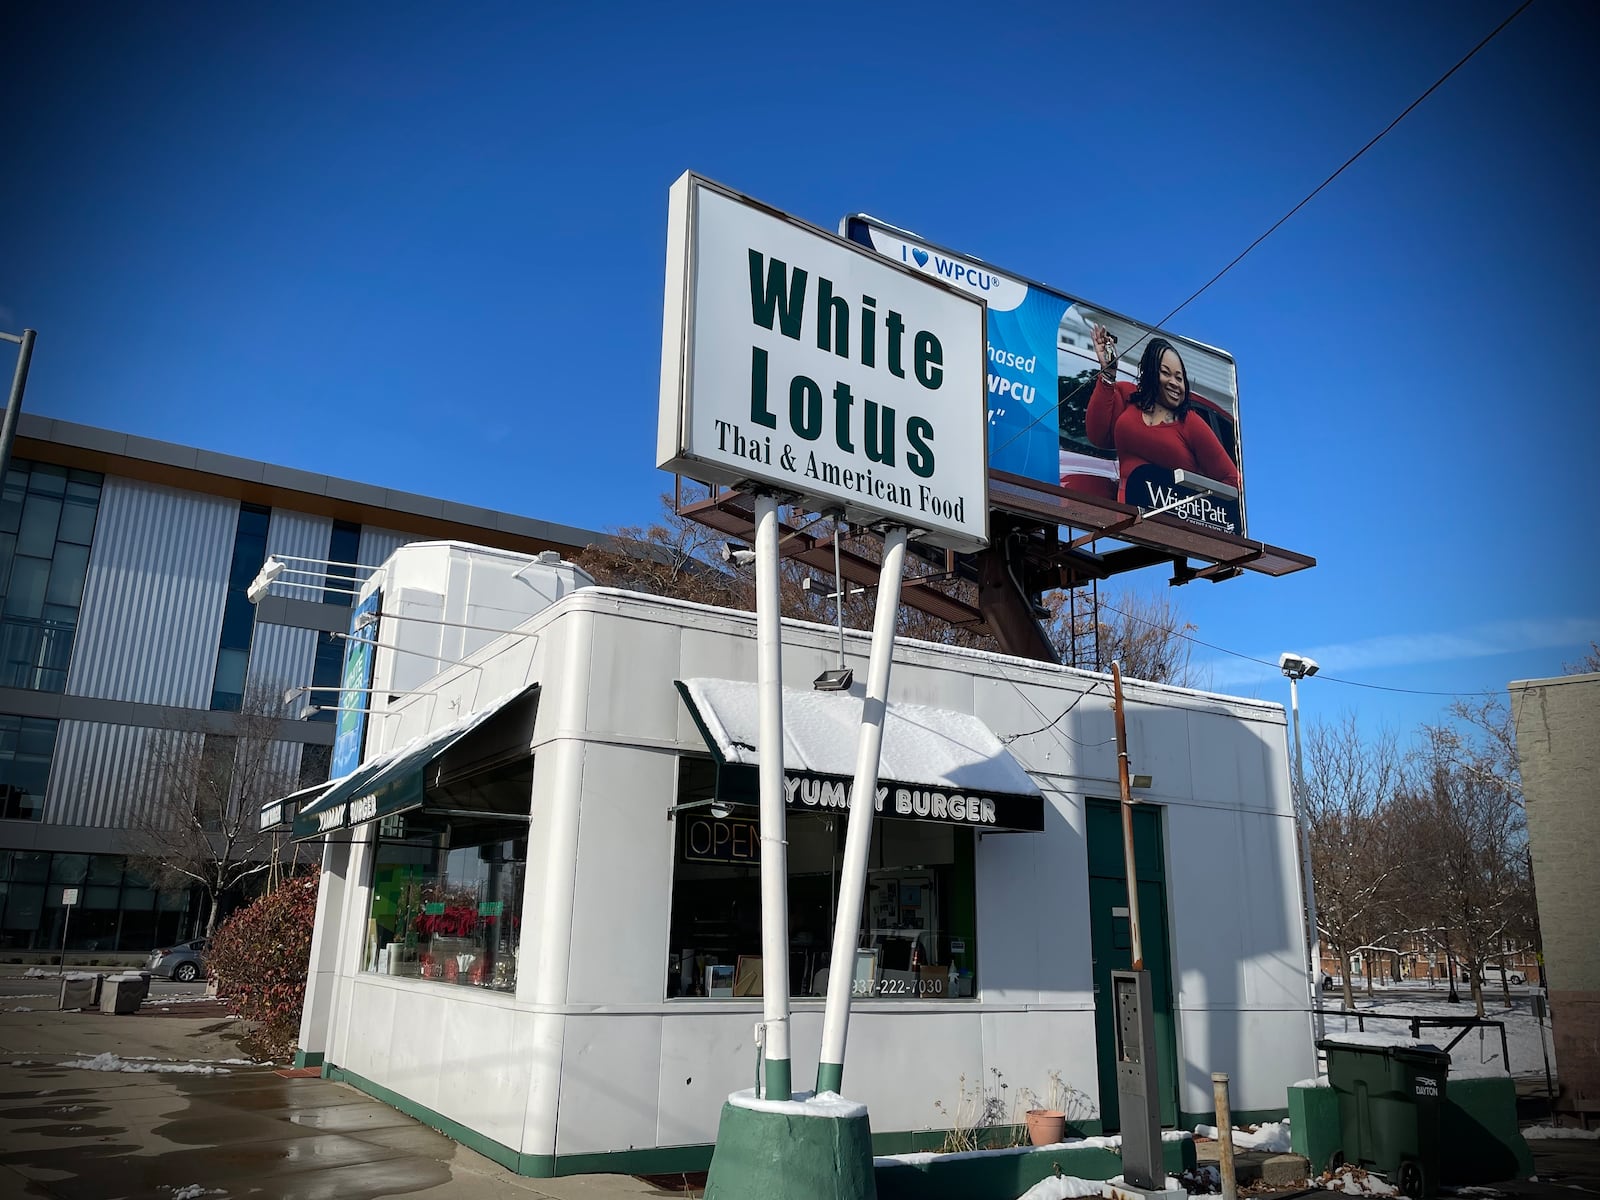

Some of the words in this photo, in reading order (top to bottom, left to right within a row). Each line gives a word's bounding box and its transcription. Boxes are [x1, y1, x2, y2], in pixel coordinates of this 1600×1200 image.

[902, 244, 907, 262] I
[748, 247, 944, 391] White
[751, 346, 935, 479] Lotus
[715, 419, 772, 466] Thai
[780, 444, 797, 473] &
[804, 450, 912, 508] American
[919, 484, 966, 524] Food
[783, 775, 889, 812] YUMY
[895, 788, 997, 824] BURGER
[1415, 1085, 1438, 1096] DAYTON
